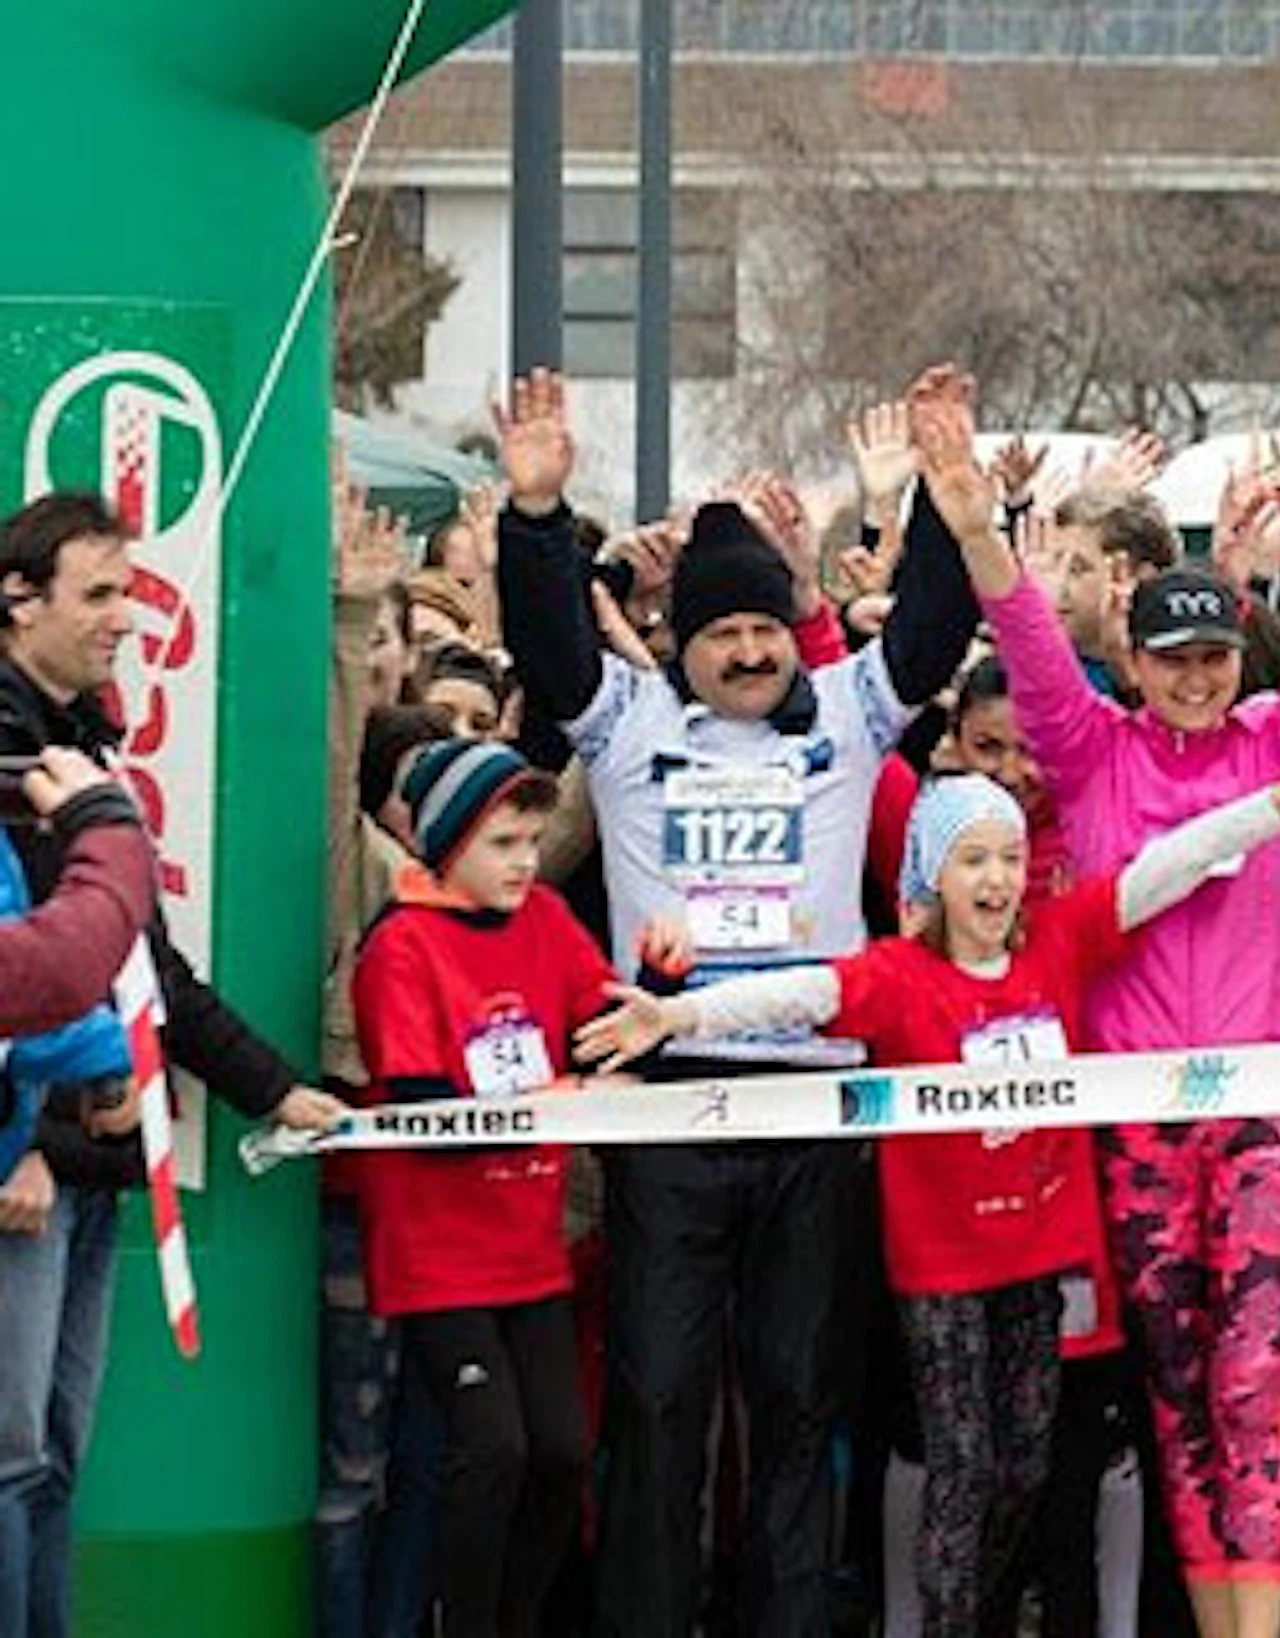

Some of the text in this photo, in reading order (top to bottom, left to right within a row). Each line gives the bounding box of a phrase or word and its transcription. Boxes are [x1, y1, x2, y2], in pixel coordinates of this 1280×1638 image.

[1165, 590, 1222, 617] TYR
[674, 810, 788, 862] 1122
[718, 904, 759, 932] 54
[916, 1077, 1077, 1117] Roxtec
